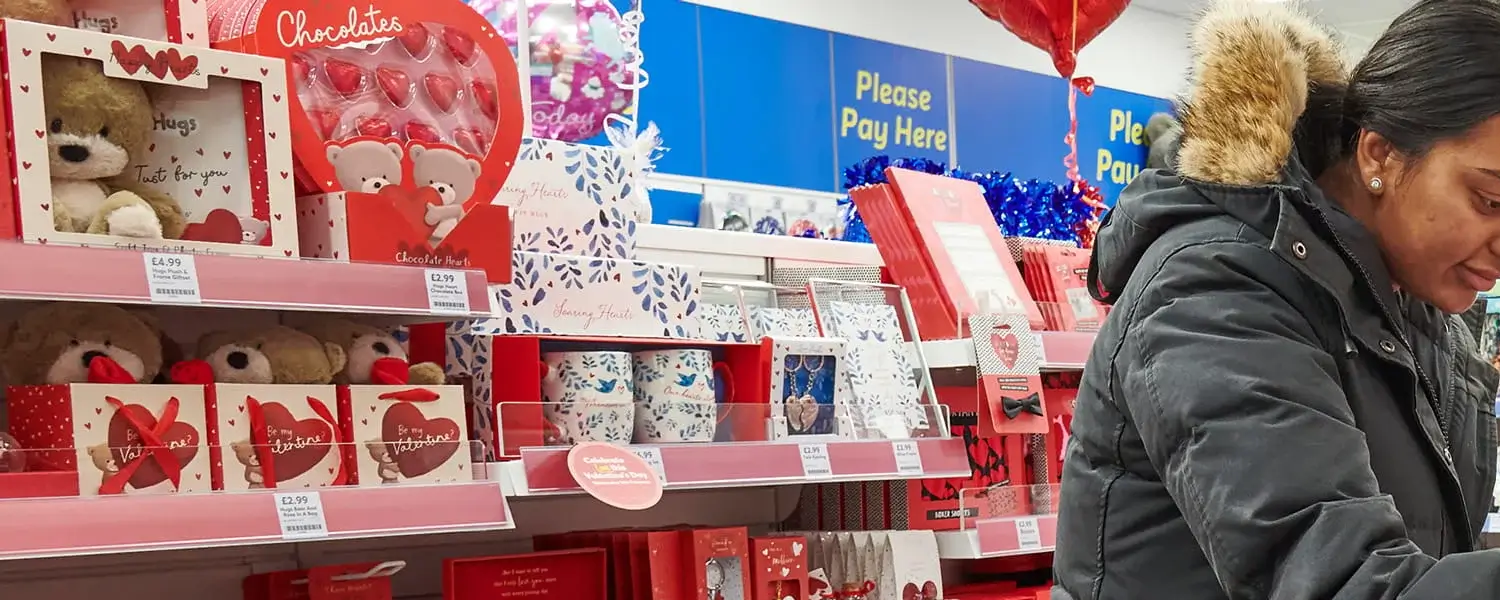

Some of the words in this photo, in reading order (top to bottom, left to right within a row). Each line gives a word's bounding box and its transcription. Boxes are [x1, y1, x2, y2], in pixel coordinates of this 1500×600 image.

[72, 9, 118, 34] Hugs
[277, 4, 403, 48] Chocolates
[856, 69, 932, 111] Please
[152, 112, 197, 137] Hugs
[841, 106, 888, 150] Pay
[894, 115, 947, 151] Here
[135, 165, 167, 184] Just
[175, 165, 198, 181] for
[200, 170, 228, 186] you
[151, 257, 182, 267] £4.99
[446, 255, 471, 267] Hearts
[431, 273, 455, 283] £2.99
[598, 303, 633, 320] Hearts
[127, 428, 138, 441] Be
[267, 426, 278, 438] Be
[281, 428, 293, 440] my
[398, 425, 409, 436] Be
[411, 427, 423, 438] my
[392, 429, 455, 456] Valentine?
[281, 496, 308, 505] £2.99
